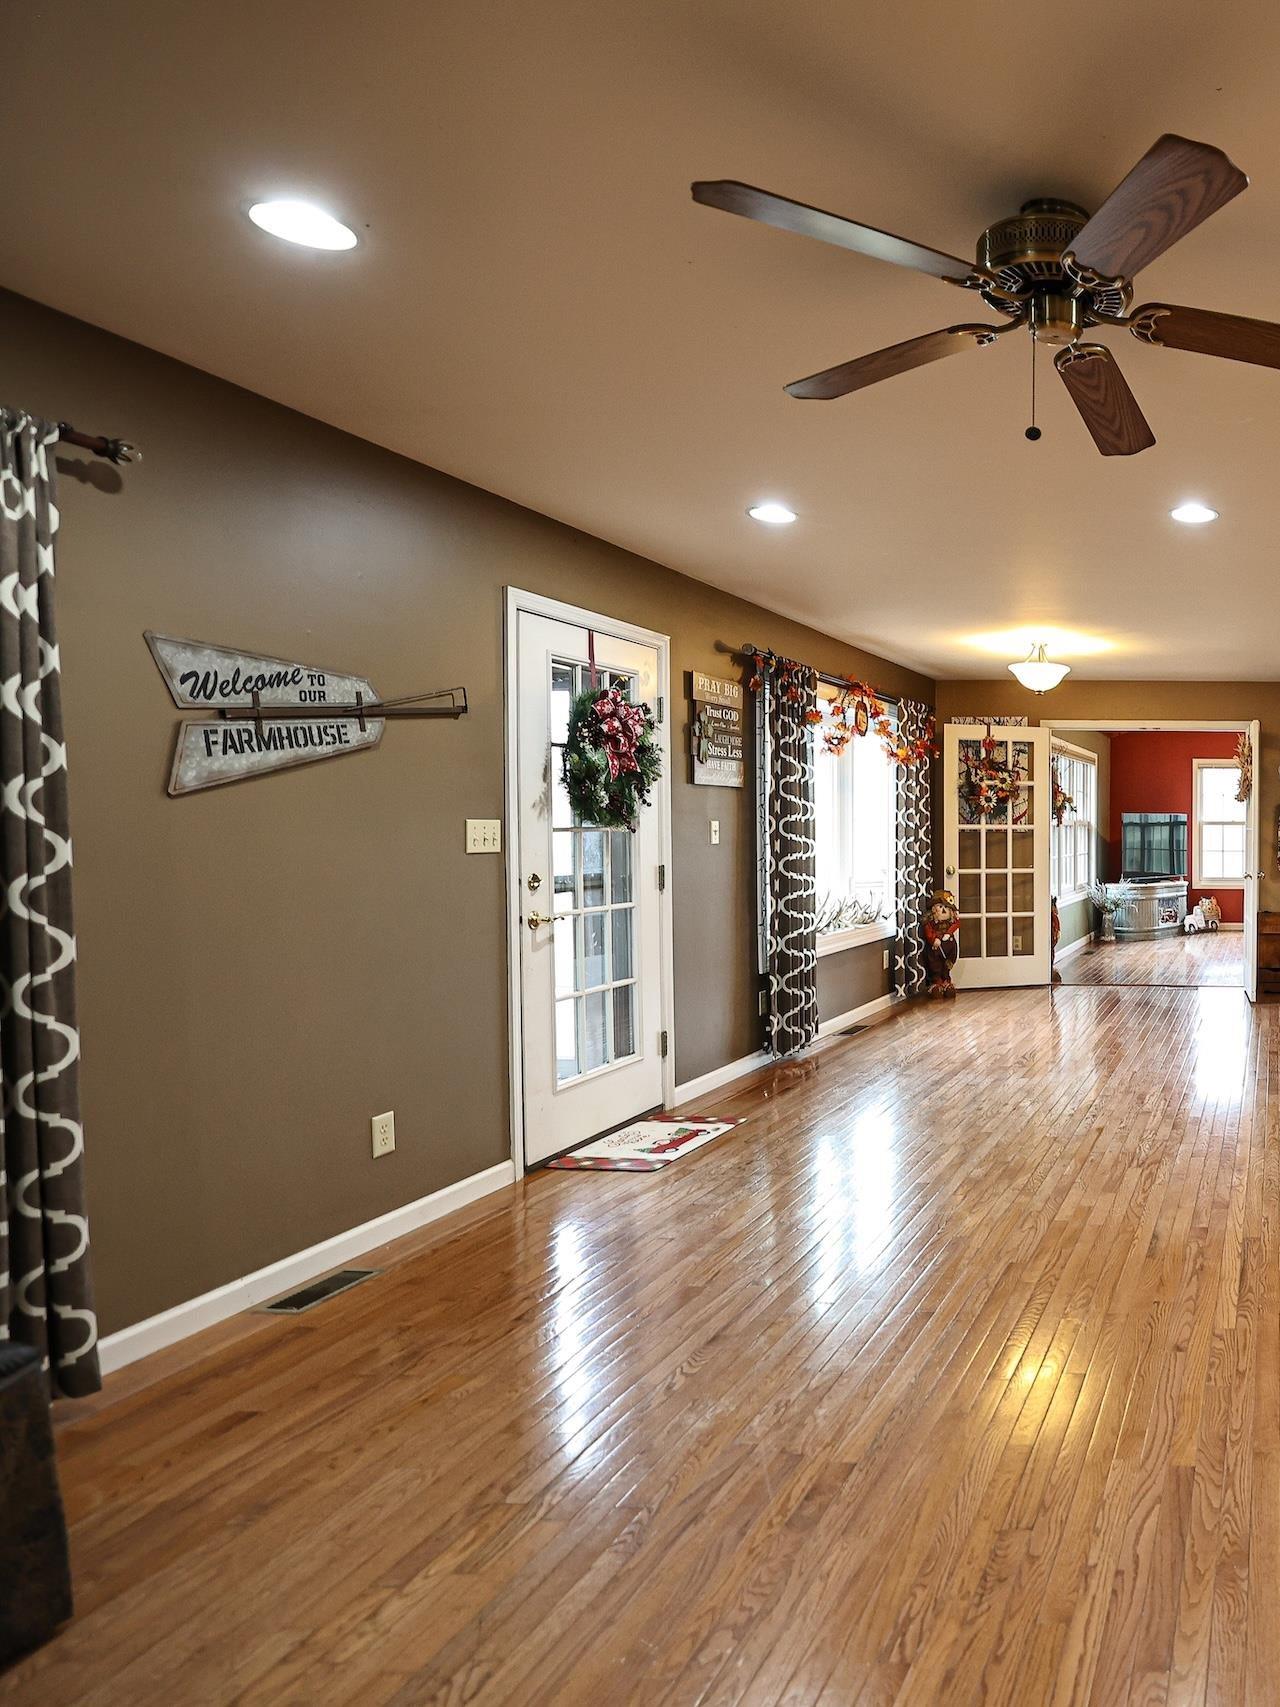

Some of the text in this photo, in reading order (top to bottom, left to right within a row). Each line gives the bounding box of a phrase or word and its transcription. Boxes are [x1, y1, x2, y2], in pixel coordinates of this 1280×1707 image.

[180, 667, 326, 700] Welcome TO
[698, 677, 739, 698] PRAY BIG
[299, 689, 326, 702] OUR
[705, 704, 739, 722] Trust GOD
[203, 724, 350, 757] FARMHOUSE
[707, 741, 743, 759] Stress Less
